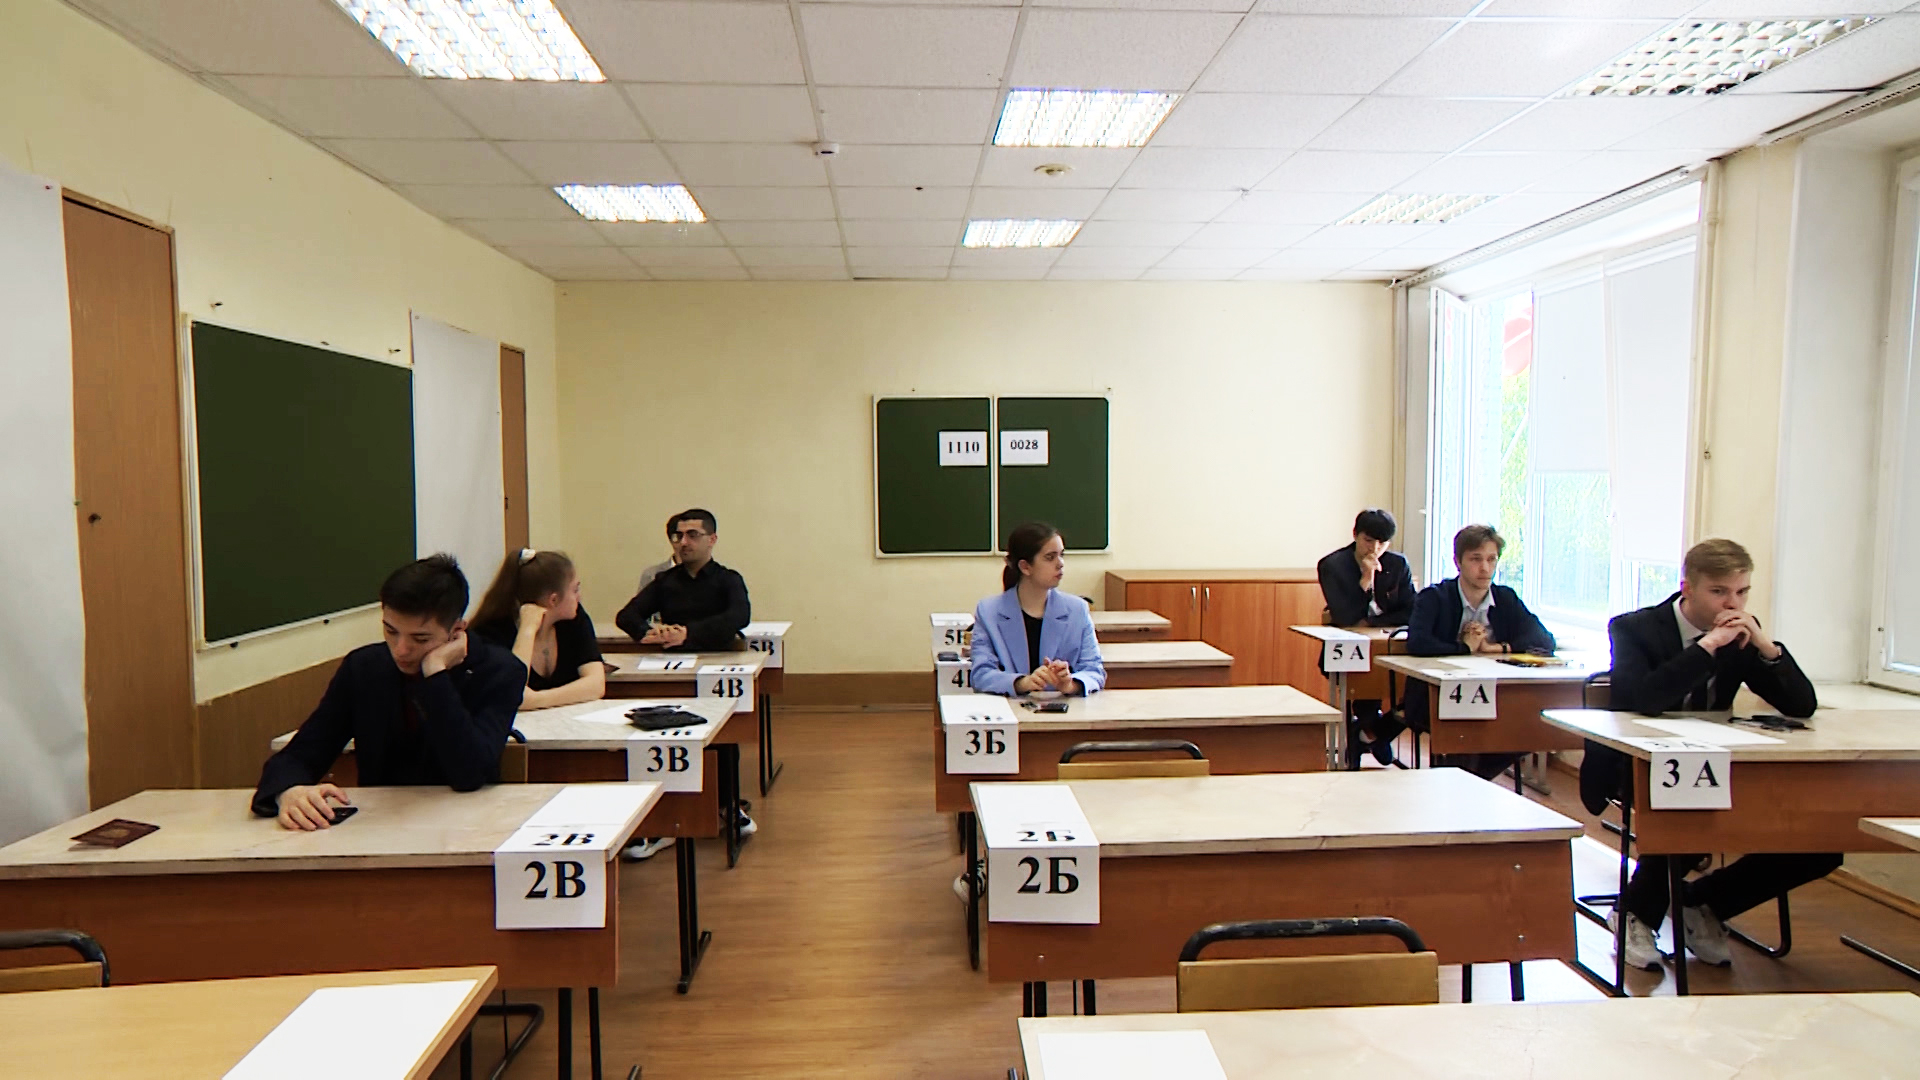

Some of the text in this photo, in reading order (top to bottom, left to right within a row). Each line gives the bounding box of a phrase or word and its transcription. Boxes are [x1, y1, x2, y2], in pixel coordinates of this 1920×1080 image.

[948, 441, 980, 454] 1110
[1010, 439, 1039, 450] 0028
[1332, 643, 1342, 661] 5
[711, 677, 744, 699] 4В
[1449, 683, 1462, 704] 4
[964, 729, 1006, 756] 3Б
[646, 745, 690, 773] 3В
[1662, 758, 1680, 788] 3
[523, 860, 586, 900] 2В
[1017, 856, 1079, 895] 2Б
